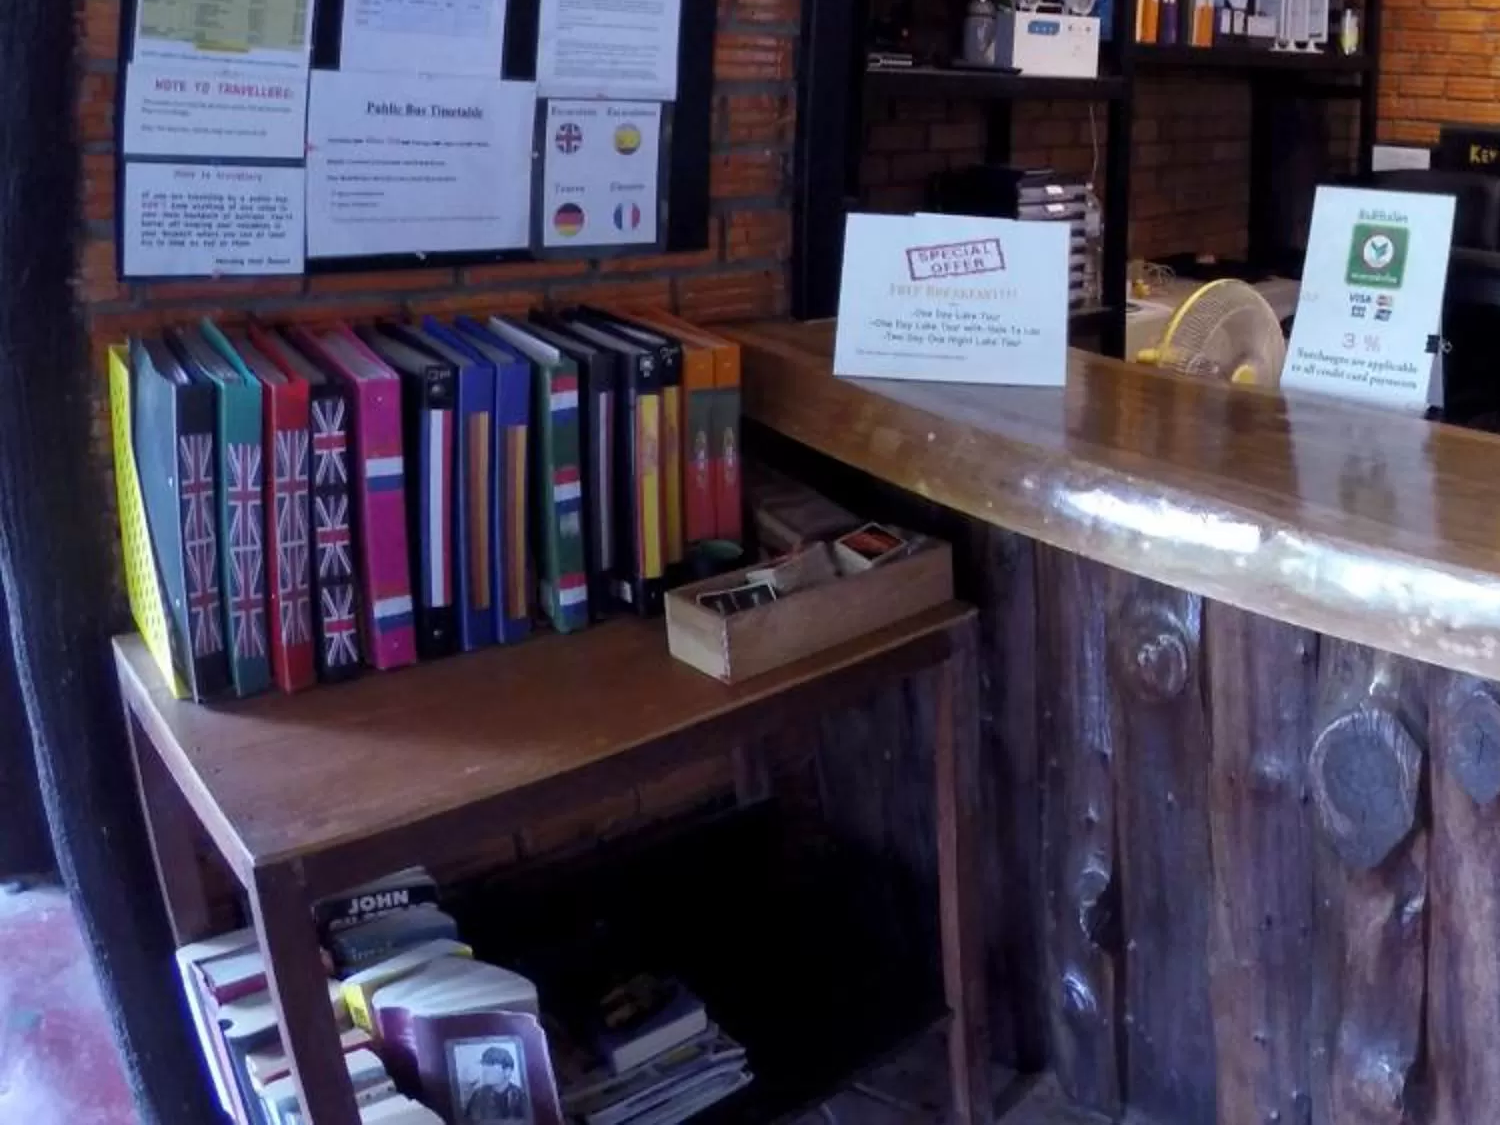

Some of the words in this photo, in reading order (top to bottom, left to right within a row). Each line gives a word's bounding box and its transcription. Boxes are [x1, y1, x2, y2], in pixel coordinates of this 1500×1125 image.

[195, 81, 211, 95] TO
[366, 101, 401, 117] Public
[405, 102, 426, 117] Bus
[429, 104, 484, 120] Timetable
[918, 242, 991, 263] SPECIAL
[930, 257, 985, 274] OFFER
[1349, 293, 1372, 304] VISA
[1343, 332, 1356, 349] 3
[1364, 334, 1381, 352] %
[1304, 365, 1316, 375] all
[1317, 366, 1345, 378] credit
[1346, 371, 1368, 383] card
[1352, 357, 1365, 366] are
[1368, 358, 1418, 373] applicable
[348, 889, 409, 915] JOHN
